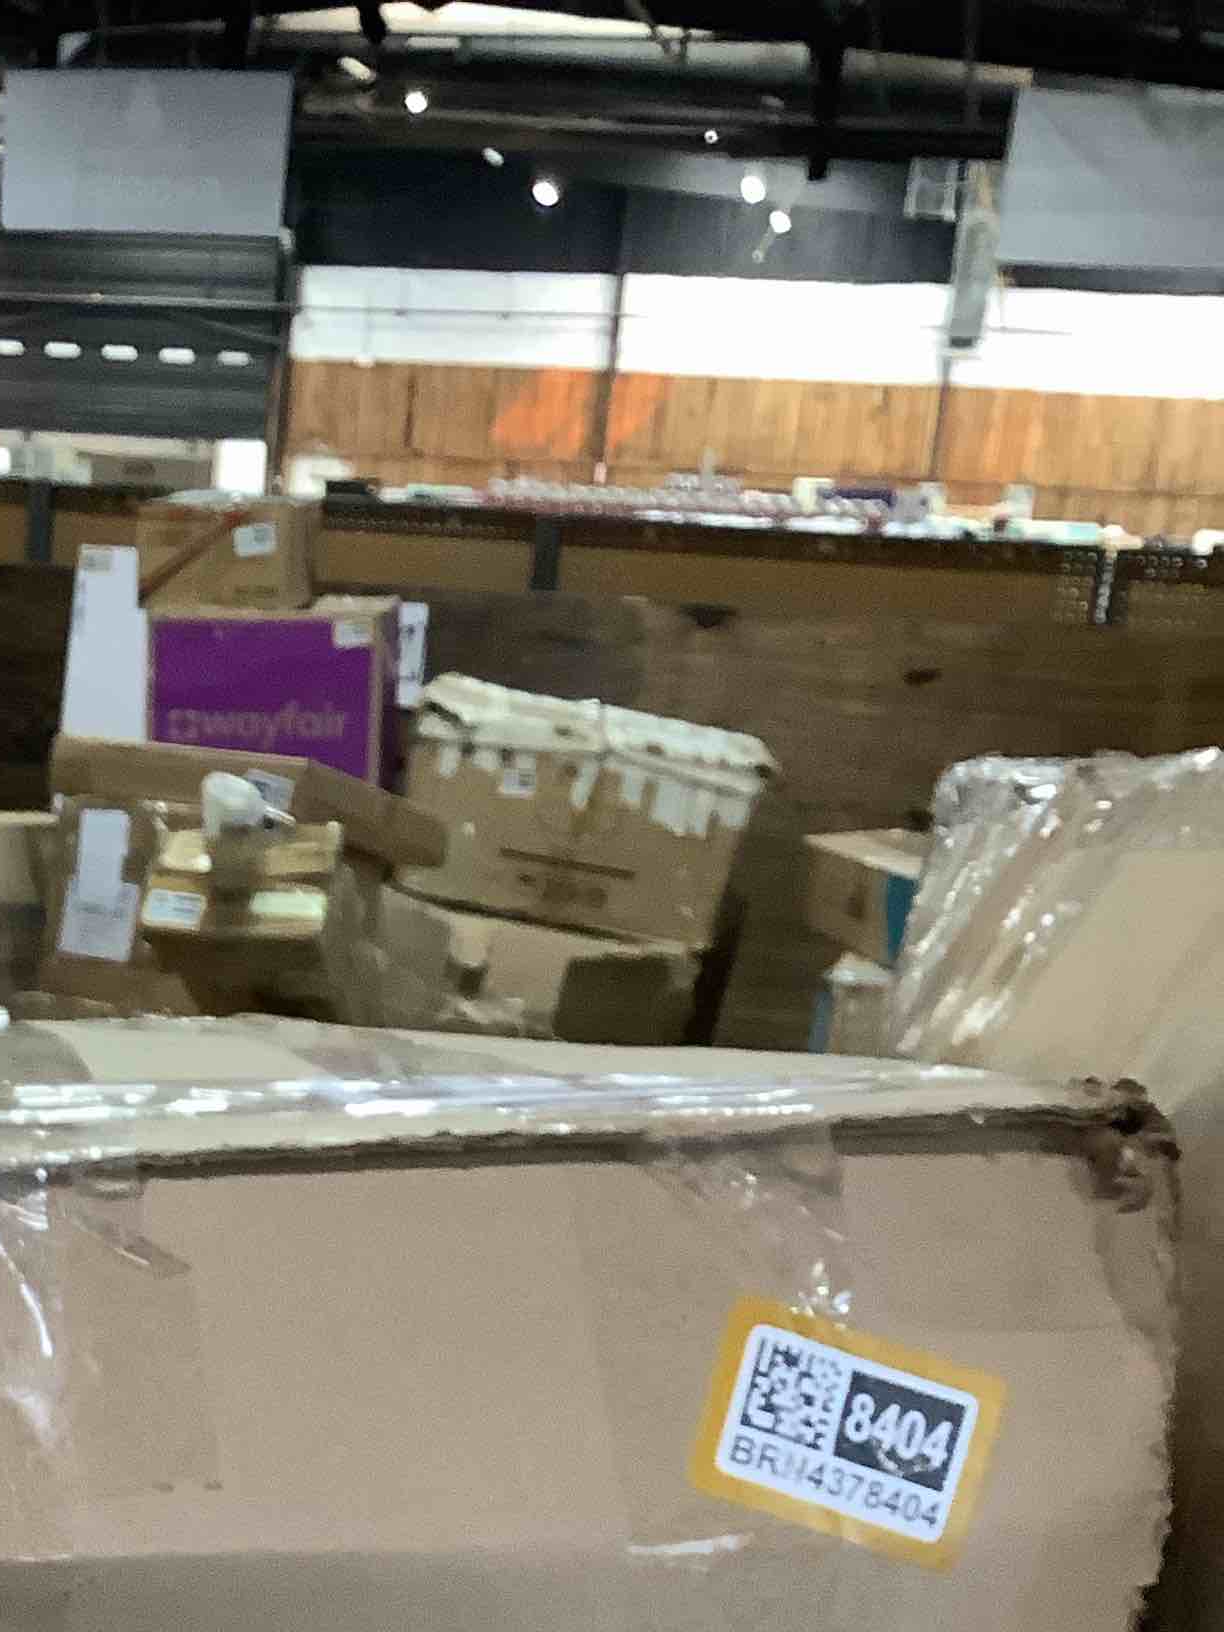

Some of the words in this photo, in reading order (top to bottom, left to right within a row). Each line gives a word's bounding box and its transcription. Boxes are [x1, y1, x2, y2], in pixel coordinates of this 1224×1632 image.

[200, 699, 347, 749] wayfair
[843, 1393, 953, 1473] 8404
[728, 1433, 941, 1529] BRN4378404
